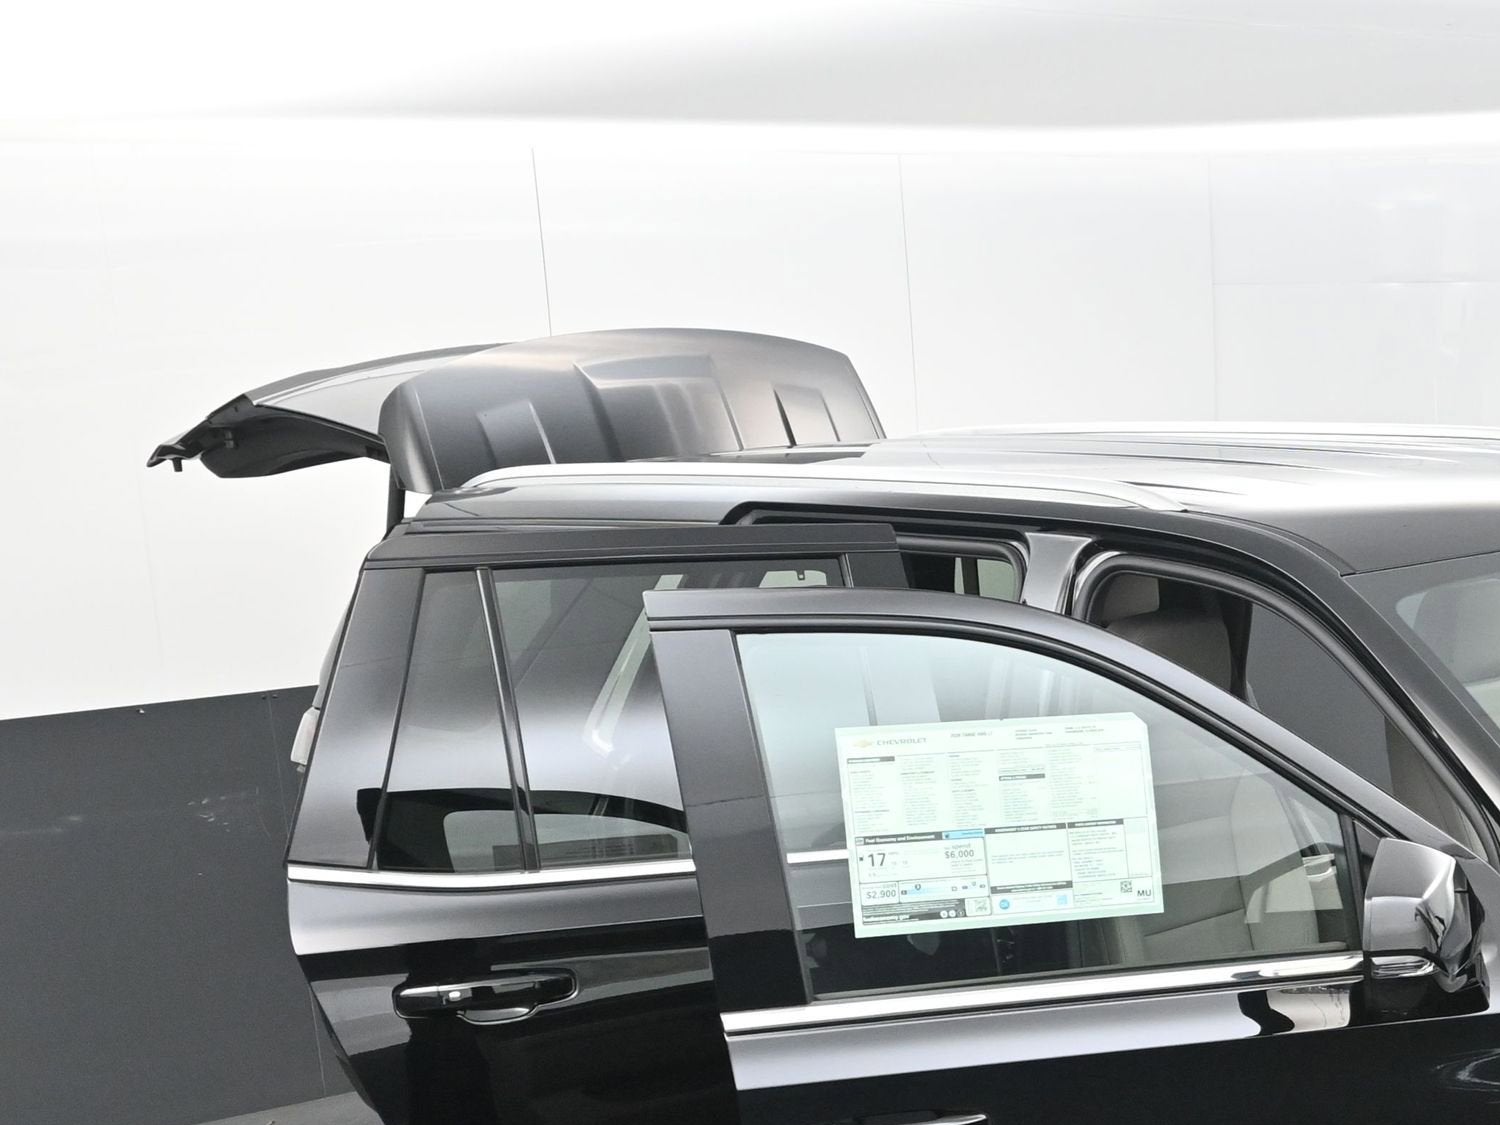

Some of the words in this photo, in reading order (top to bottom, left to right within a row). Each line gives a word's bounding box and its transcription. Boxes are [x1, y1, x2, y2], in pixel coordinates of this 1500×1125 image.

[877, 737, 927, 746] CHEVROLET
[867, 851, 886, 867] 17
[944, 849, 975, 860] $6,000
[866, 889, 897, 899] $2,900
[1136, 888, 1152, 897] MU
